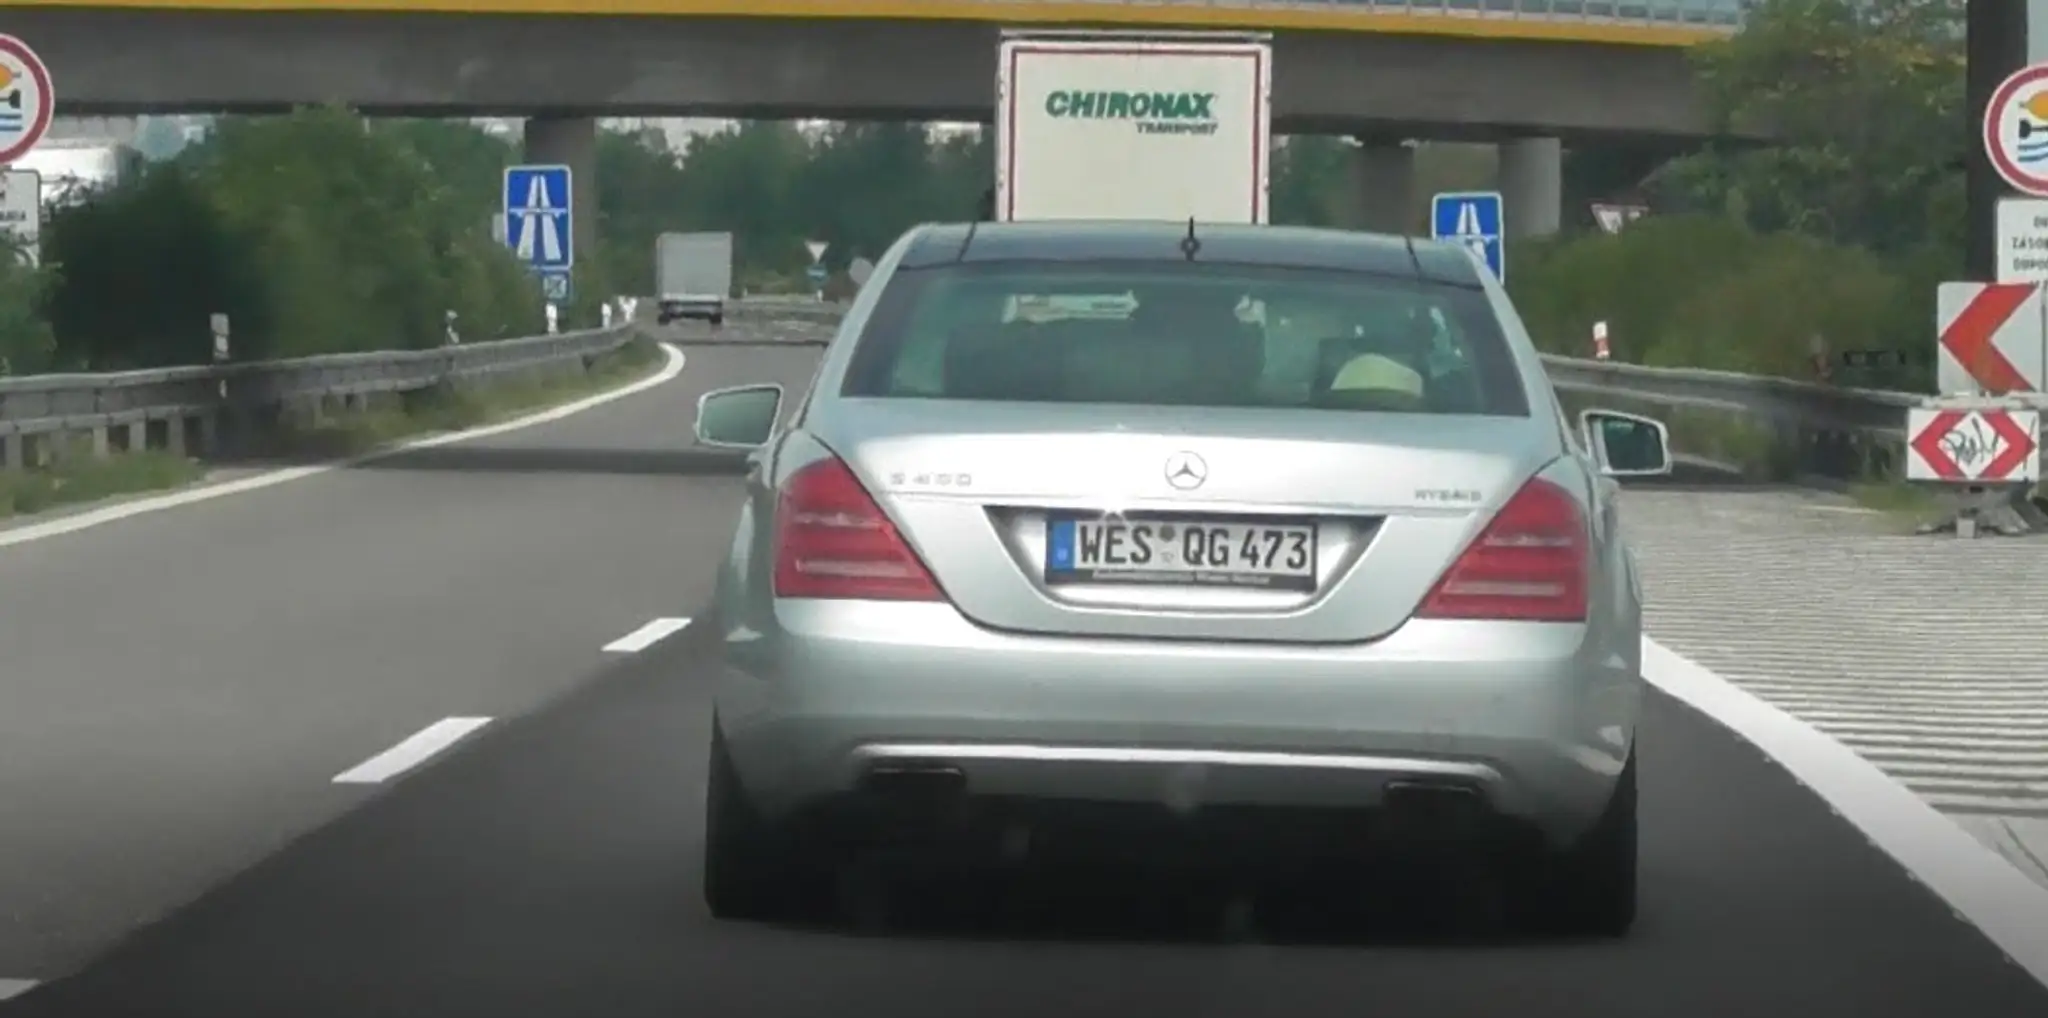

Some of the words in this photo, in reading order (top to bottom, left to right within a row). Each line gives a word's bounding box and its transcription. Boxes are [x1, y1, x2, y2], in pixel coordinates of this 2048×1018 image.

[1046, 91, 1216, 118] CHIRONAX
[1136, 122, 1219, 134] TRANSPORT
[1079, 525, 1152, 564] WES
[1182, 527, 1230, 567] QG
[1239, 529, 1307, 570] 473
